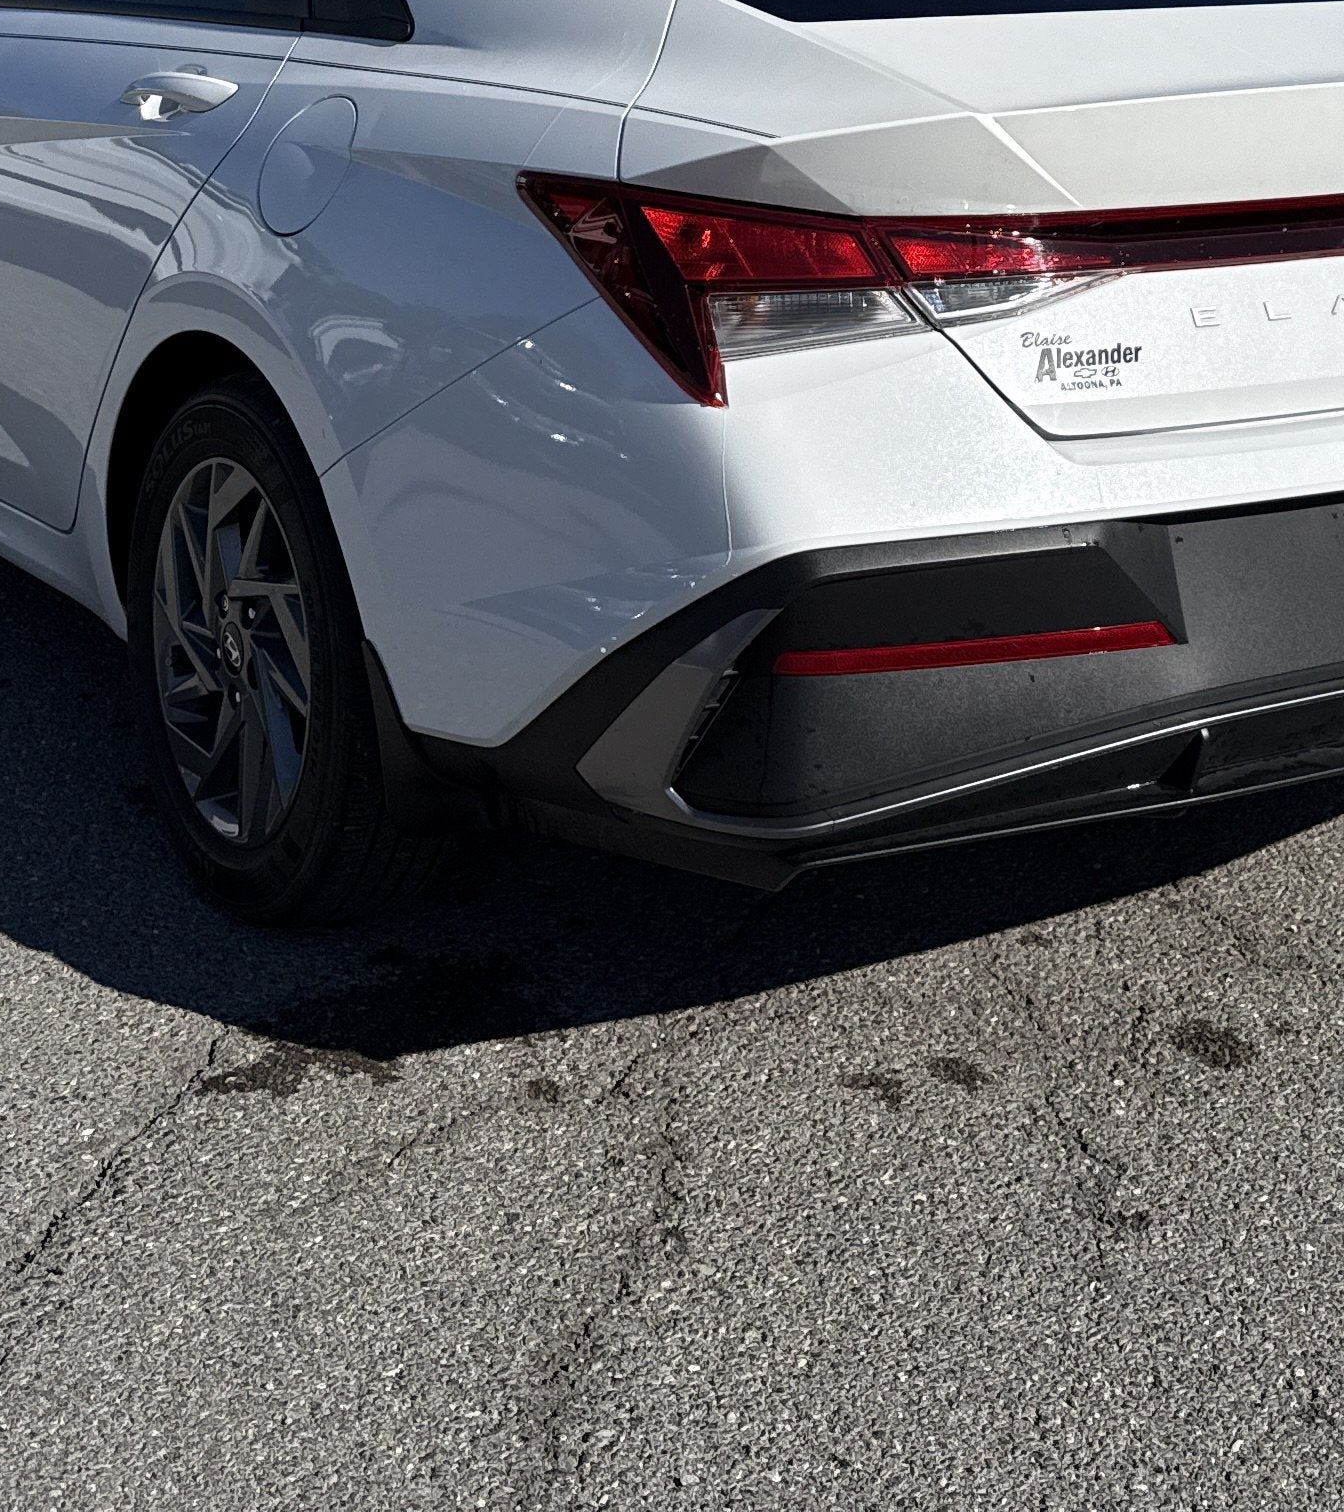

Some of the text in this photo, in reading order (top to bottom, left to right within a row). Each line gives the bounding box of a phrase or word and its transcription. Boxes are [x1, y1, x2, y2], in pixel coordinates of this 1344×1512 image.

[1020, 331, 1072, 348] Blaise
[1034, 342, 1143, 383] Alexander
[1109, 378, 1123, 387] PA
